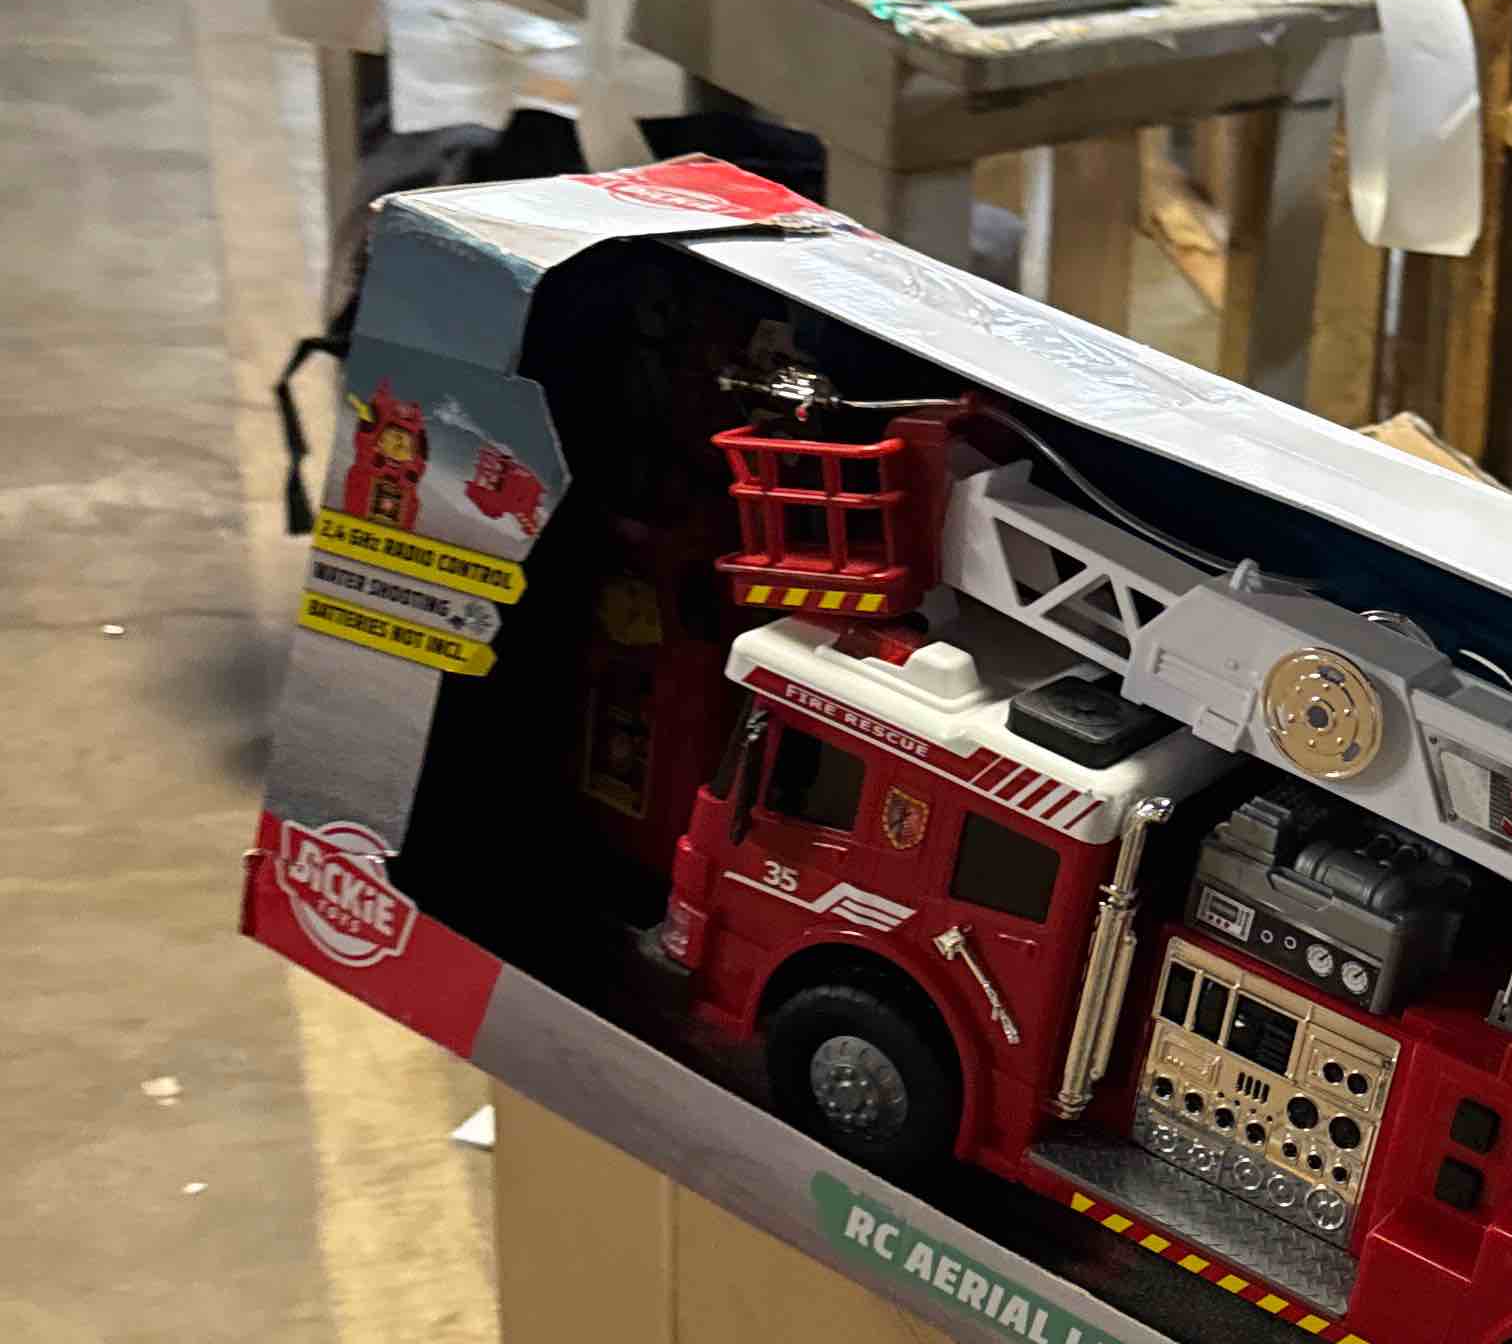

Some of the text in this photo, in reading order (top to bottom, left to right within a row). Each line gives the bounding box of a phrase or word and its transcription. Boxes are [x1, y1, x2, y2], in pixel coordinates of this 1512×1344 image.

[312, 560, 451, 617] WATER SHOOTING
[384, 537, 434, 567] RADIO
[437, 554, 513, 590] CONTROL
[307, 599, 388, 638] BATTERIES
[391, 624, 425, 649] NOT
[784, 682, 930, 758] FIRE RESCUE
[762, 860, 799, 893] 35
[844, 1203, 896, 1260] RC
